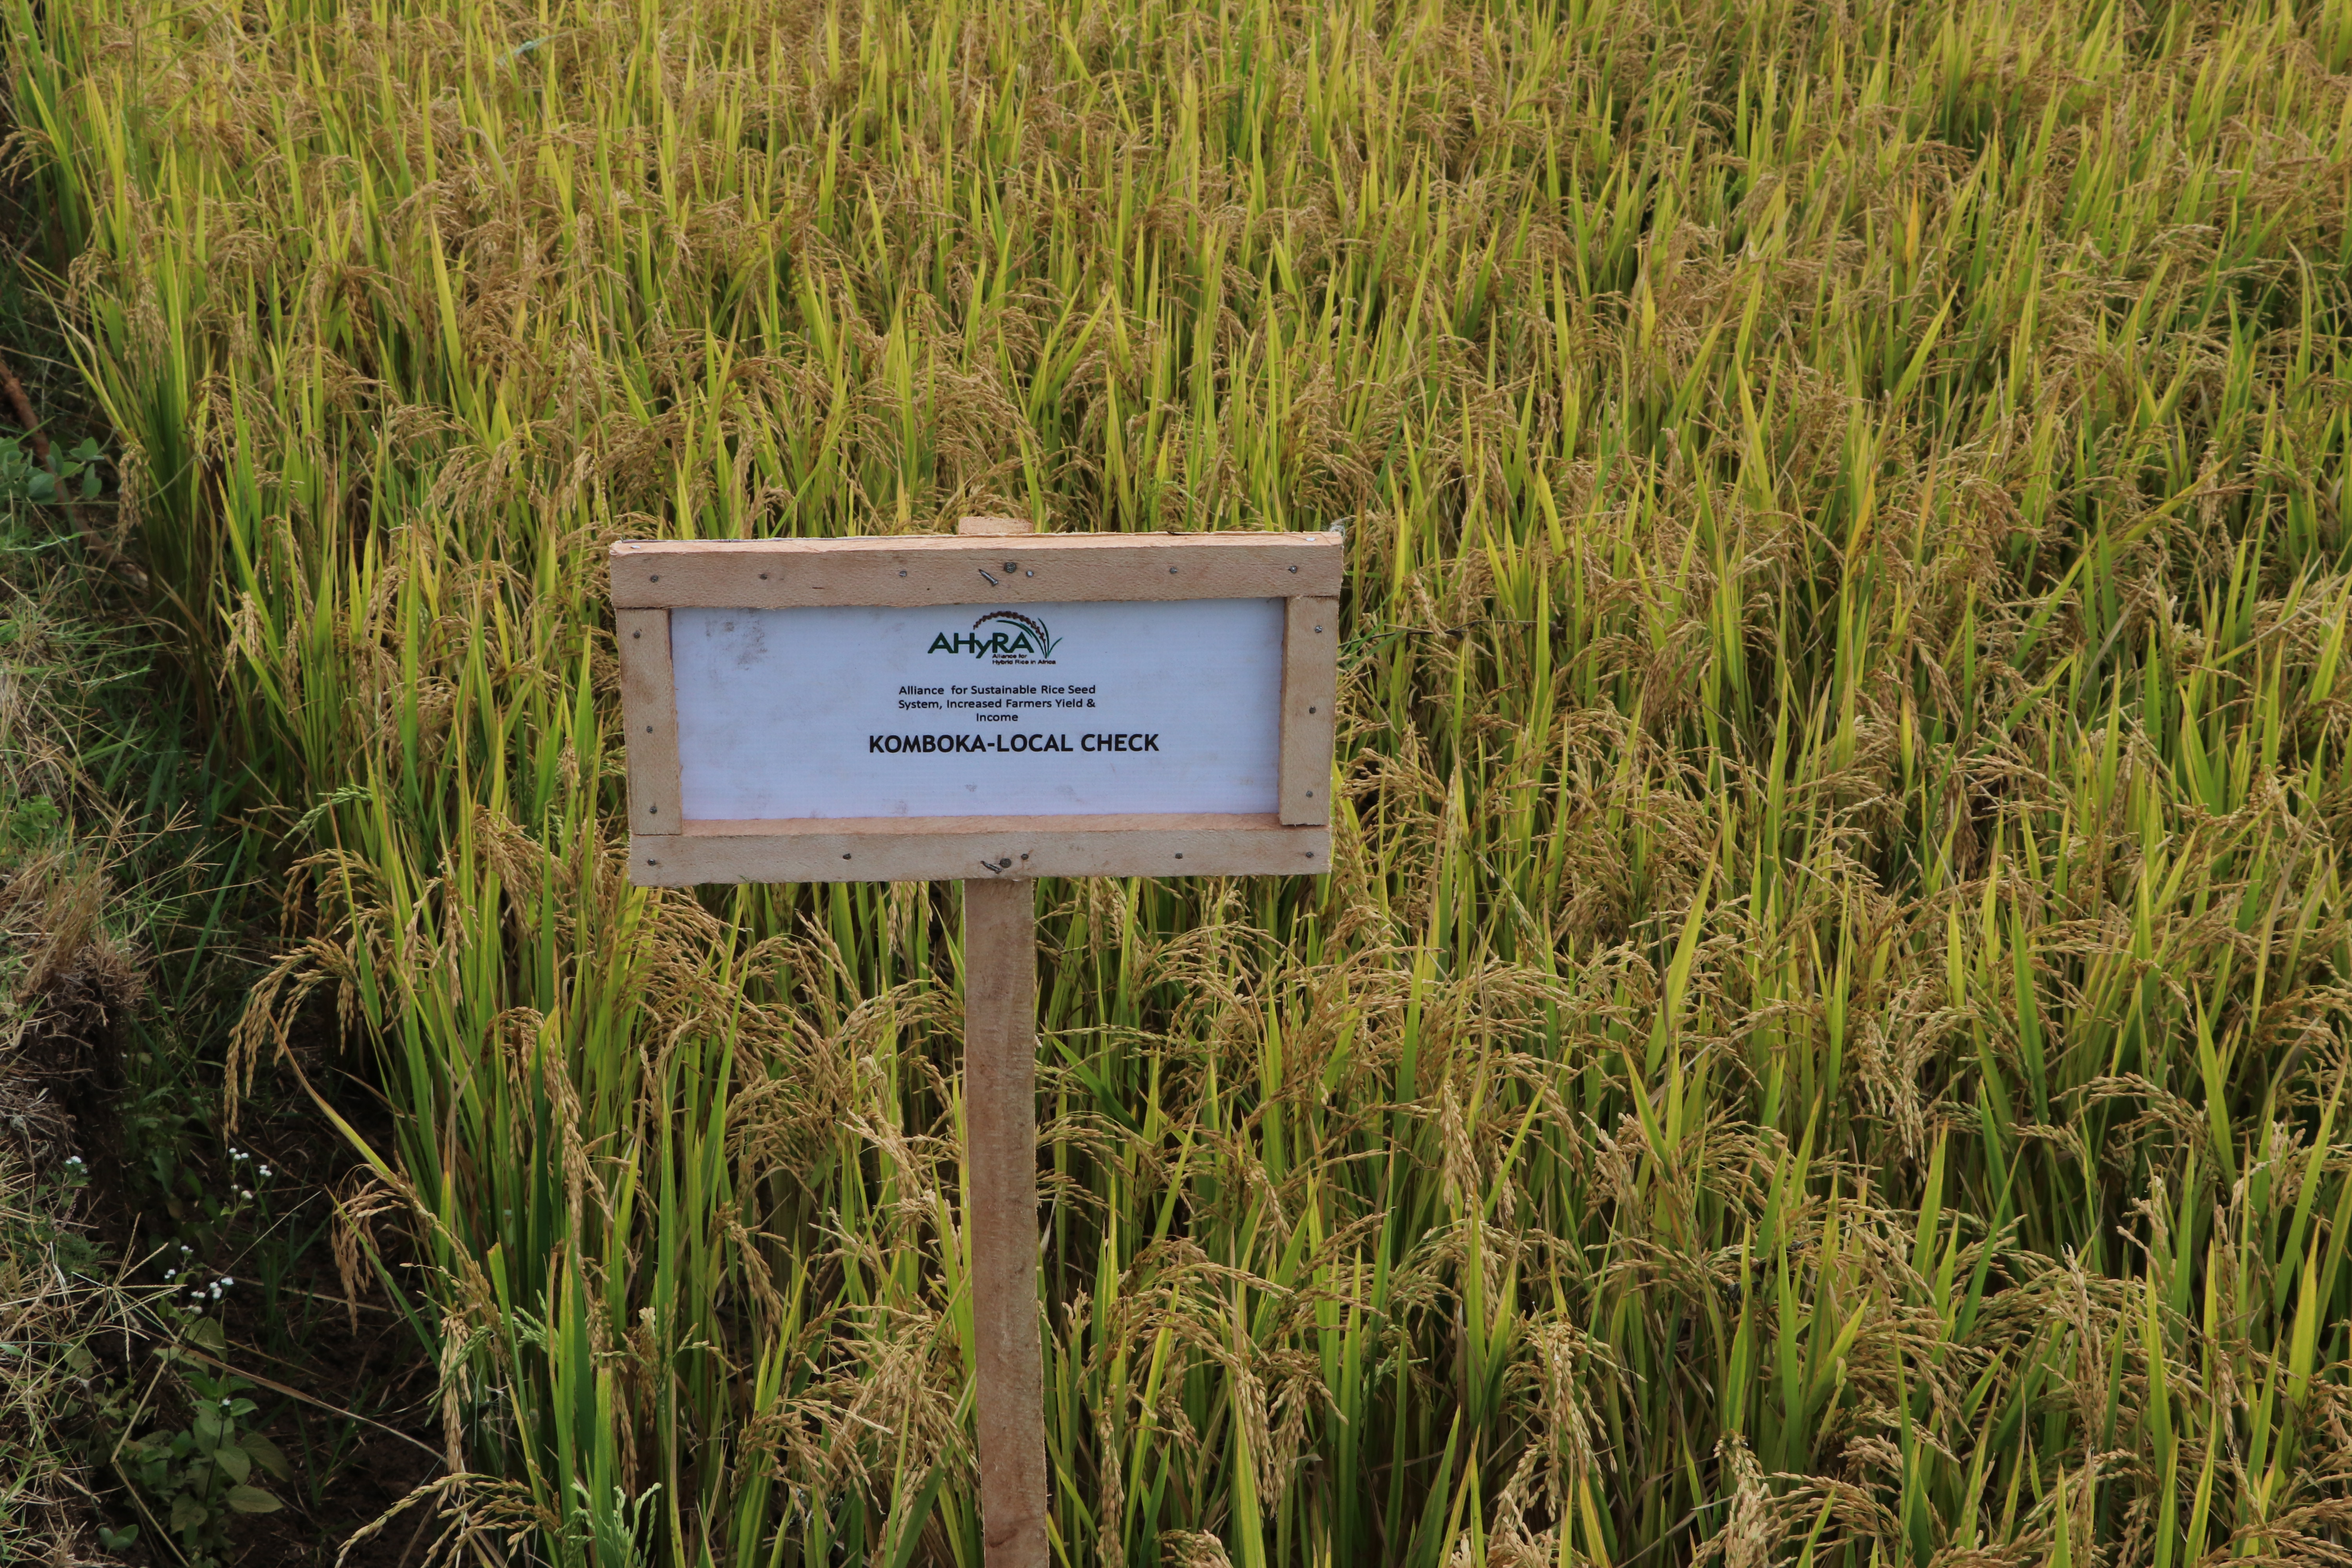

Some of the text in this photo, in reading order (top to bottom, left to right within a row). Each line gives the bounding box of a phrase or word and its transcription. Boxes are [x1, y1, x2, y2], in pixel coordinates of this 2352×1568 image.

[927, 632, 1034, 659] AHyRA
[898, 684, 1096, 695] Alliance for Sustainable Rice Seed
[898, 698, 1096, 711] System, Increased Farmers Yield &
[976, 713, 1019, 722] Income
[869, 733, 1160, 753] KOMBOKA-LOCAL CHECK
